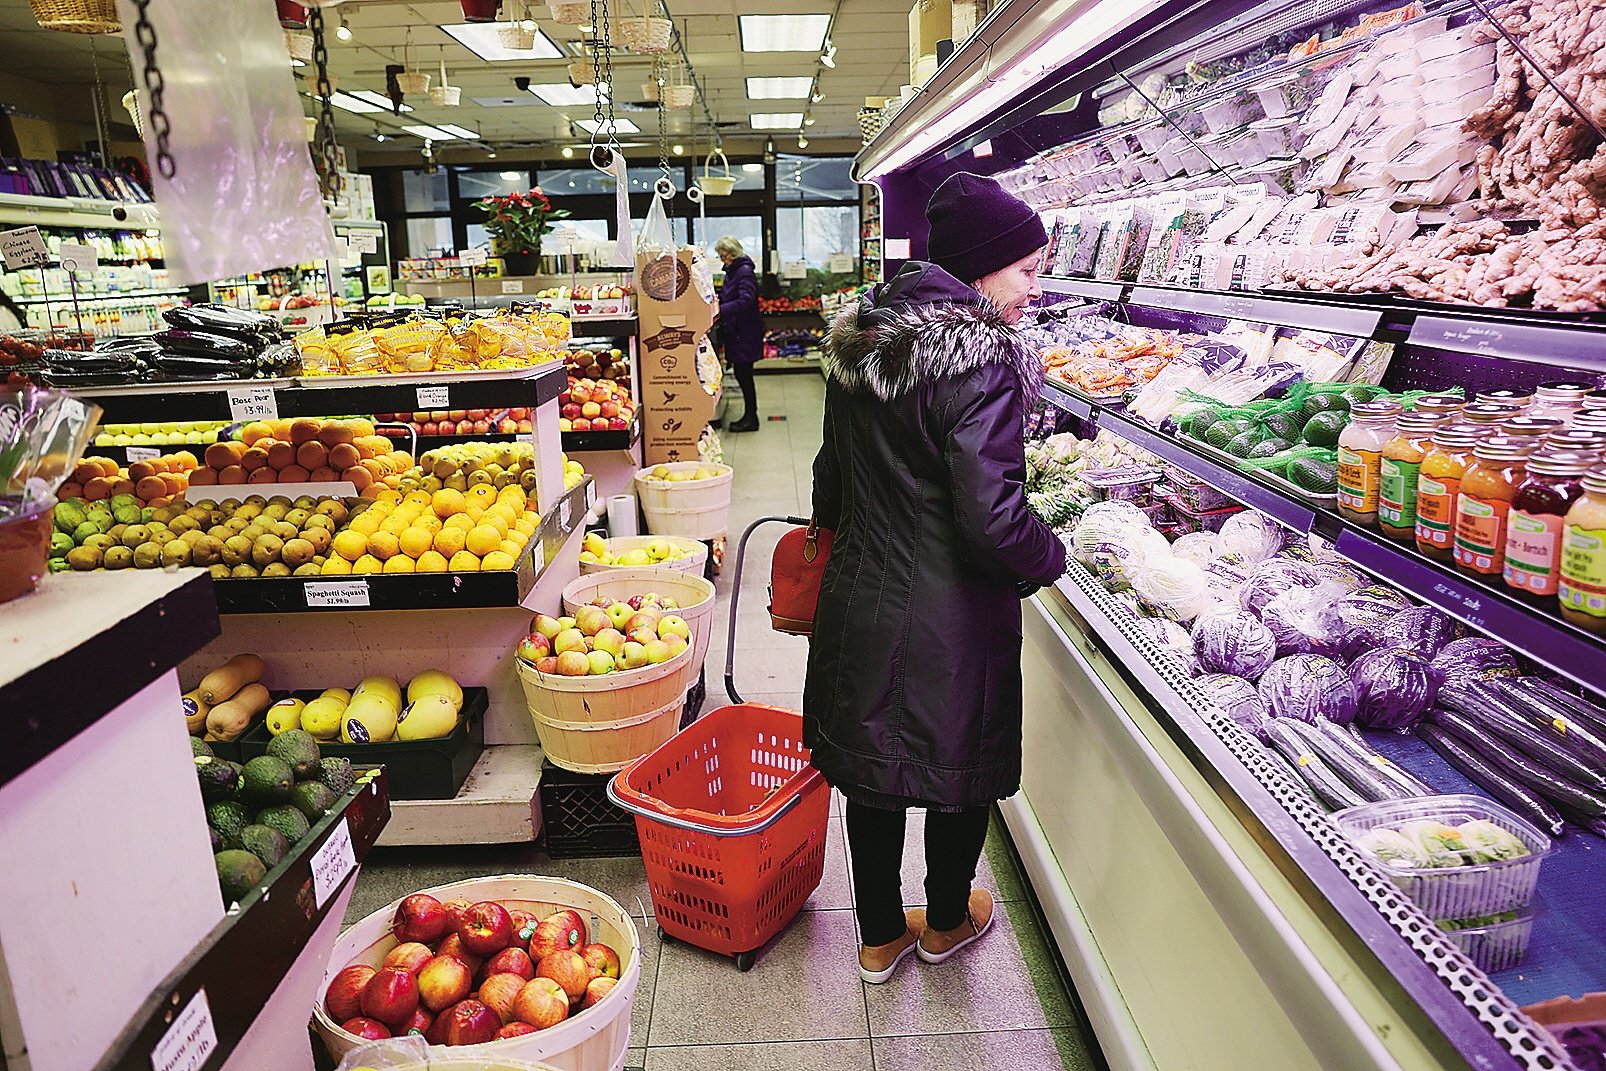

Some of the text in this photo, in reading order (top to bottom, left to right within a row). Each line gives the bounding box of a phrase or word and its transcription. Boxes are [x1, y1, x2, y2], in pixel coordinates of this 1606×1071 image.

[2, 239, 31, 250] Chinese
[9, 246, 35, 258] Eggplant
[307, 588, 366, 599] Spaghetti Squash
